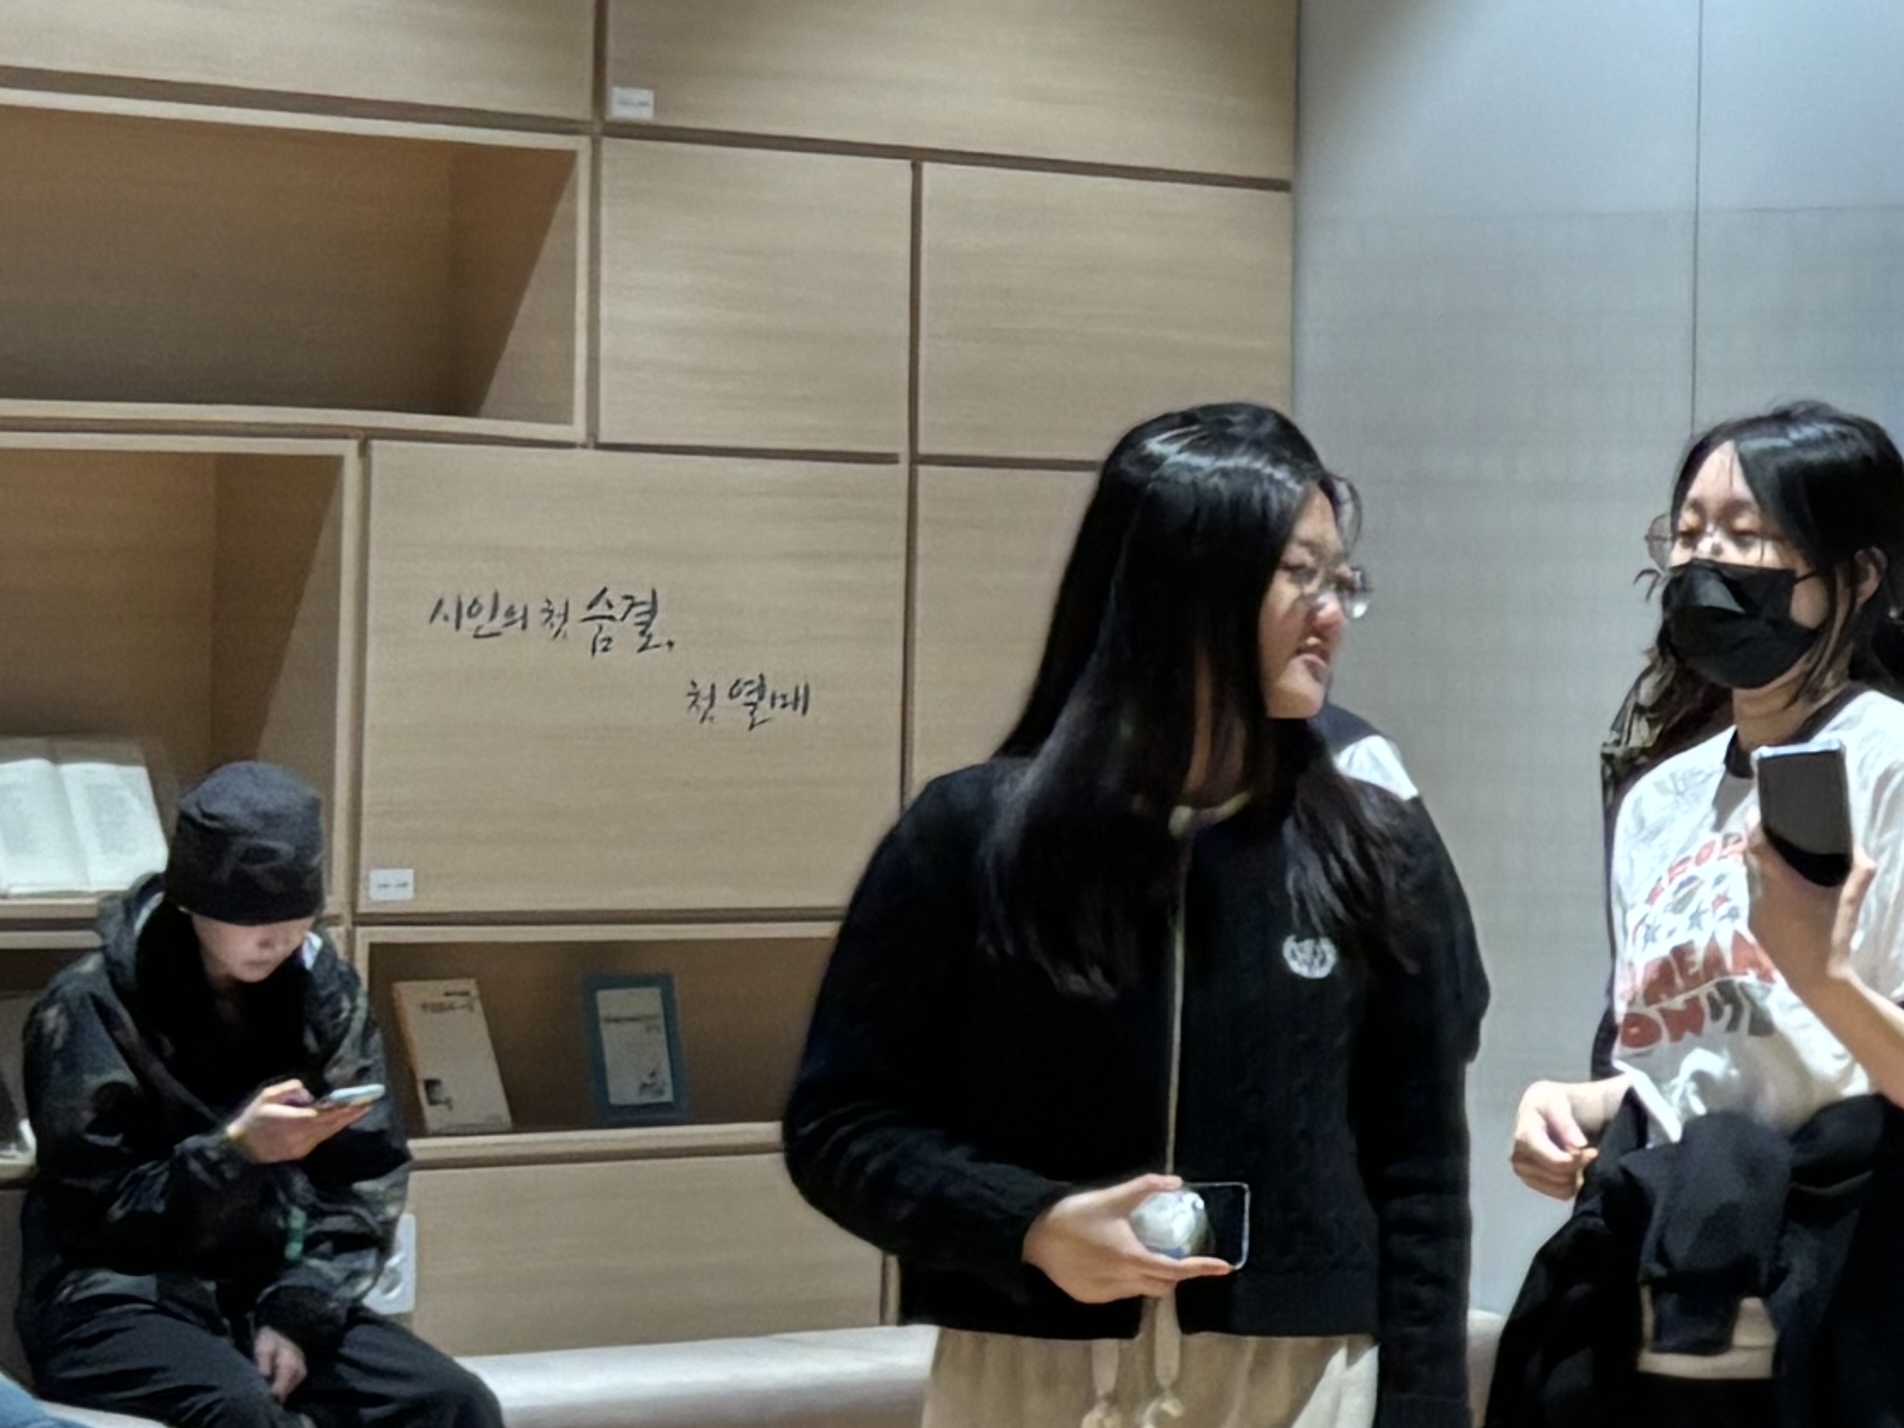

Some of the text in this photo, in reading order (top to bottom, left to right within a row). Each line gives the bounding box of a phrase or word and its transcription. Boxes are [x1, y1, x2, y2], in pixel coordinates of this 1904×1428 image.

[429, 589, 529, 641] 시인의
[540, 596, 571, 641] 첫
[686, 672, 811, 732] 첫 열매
